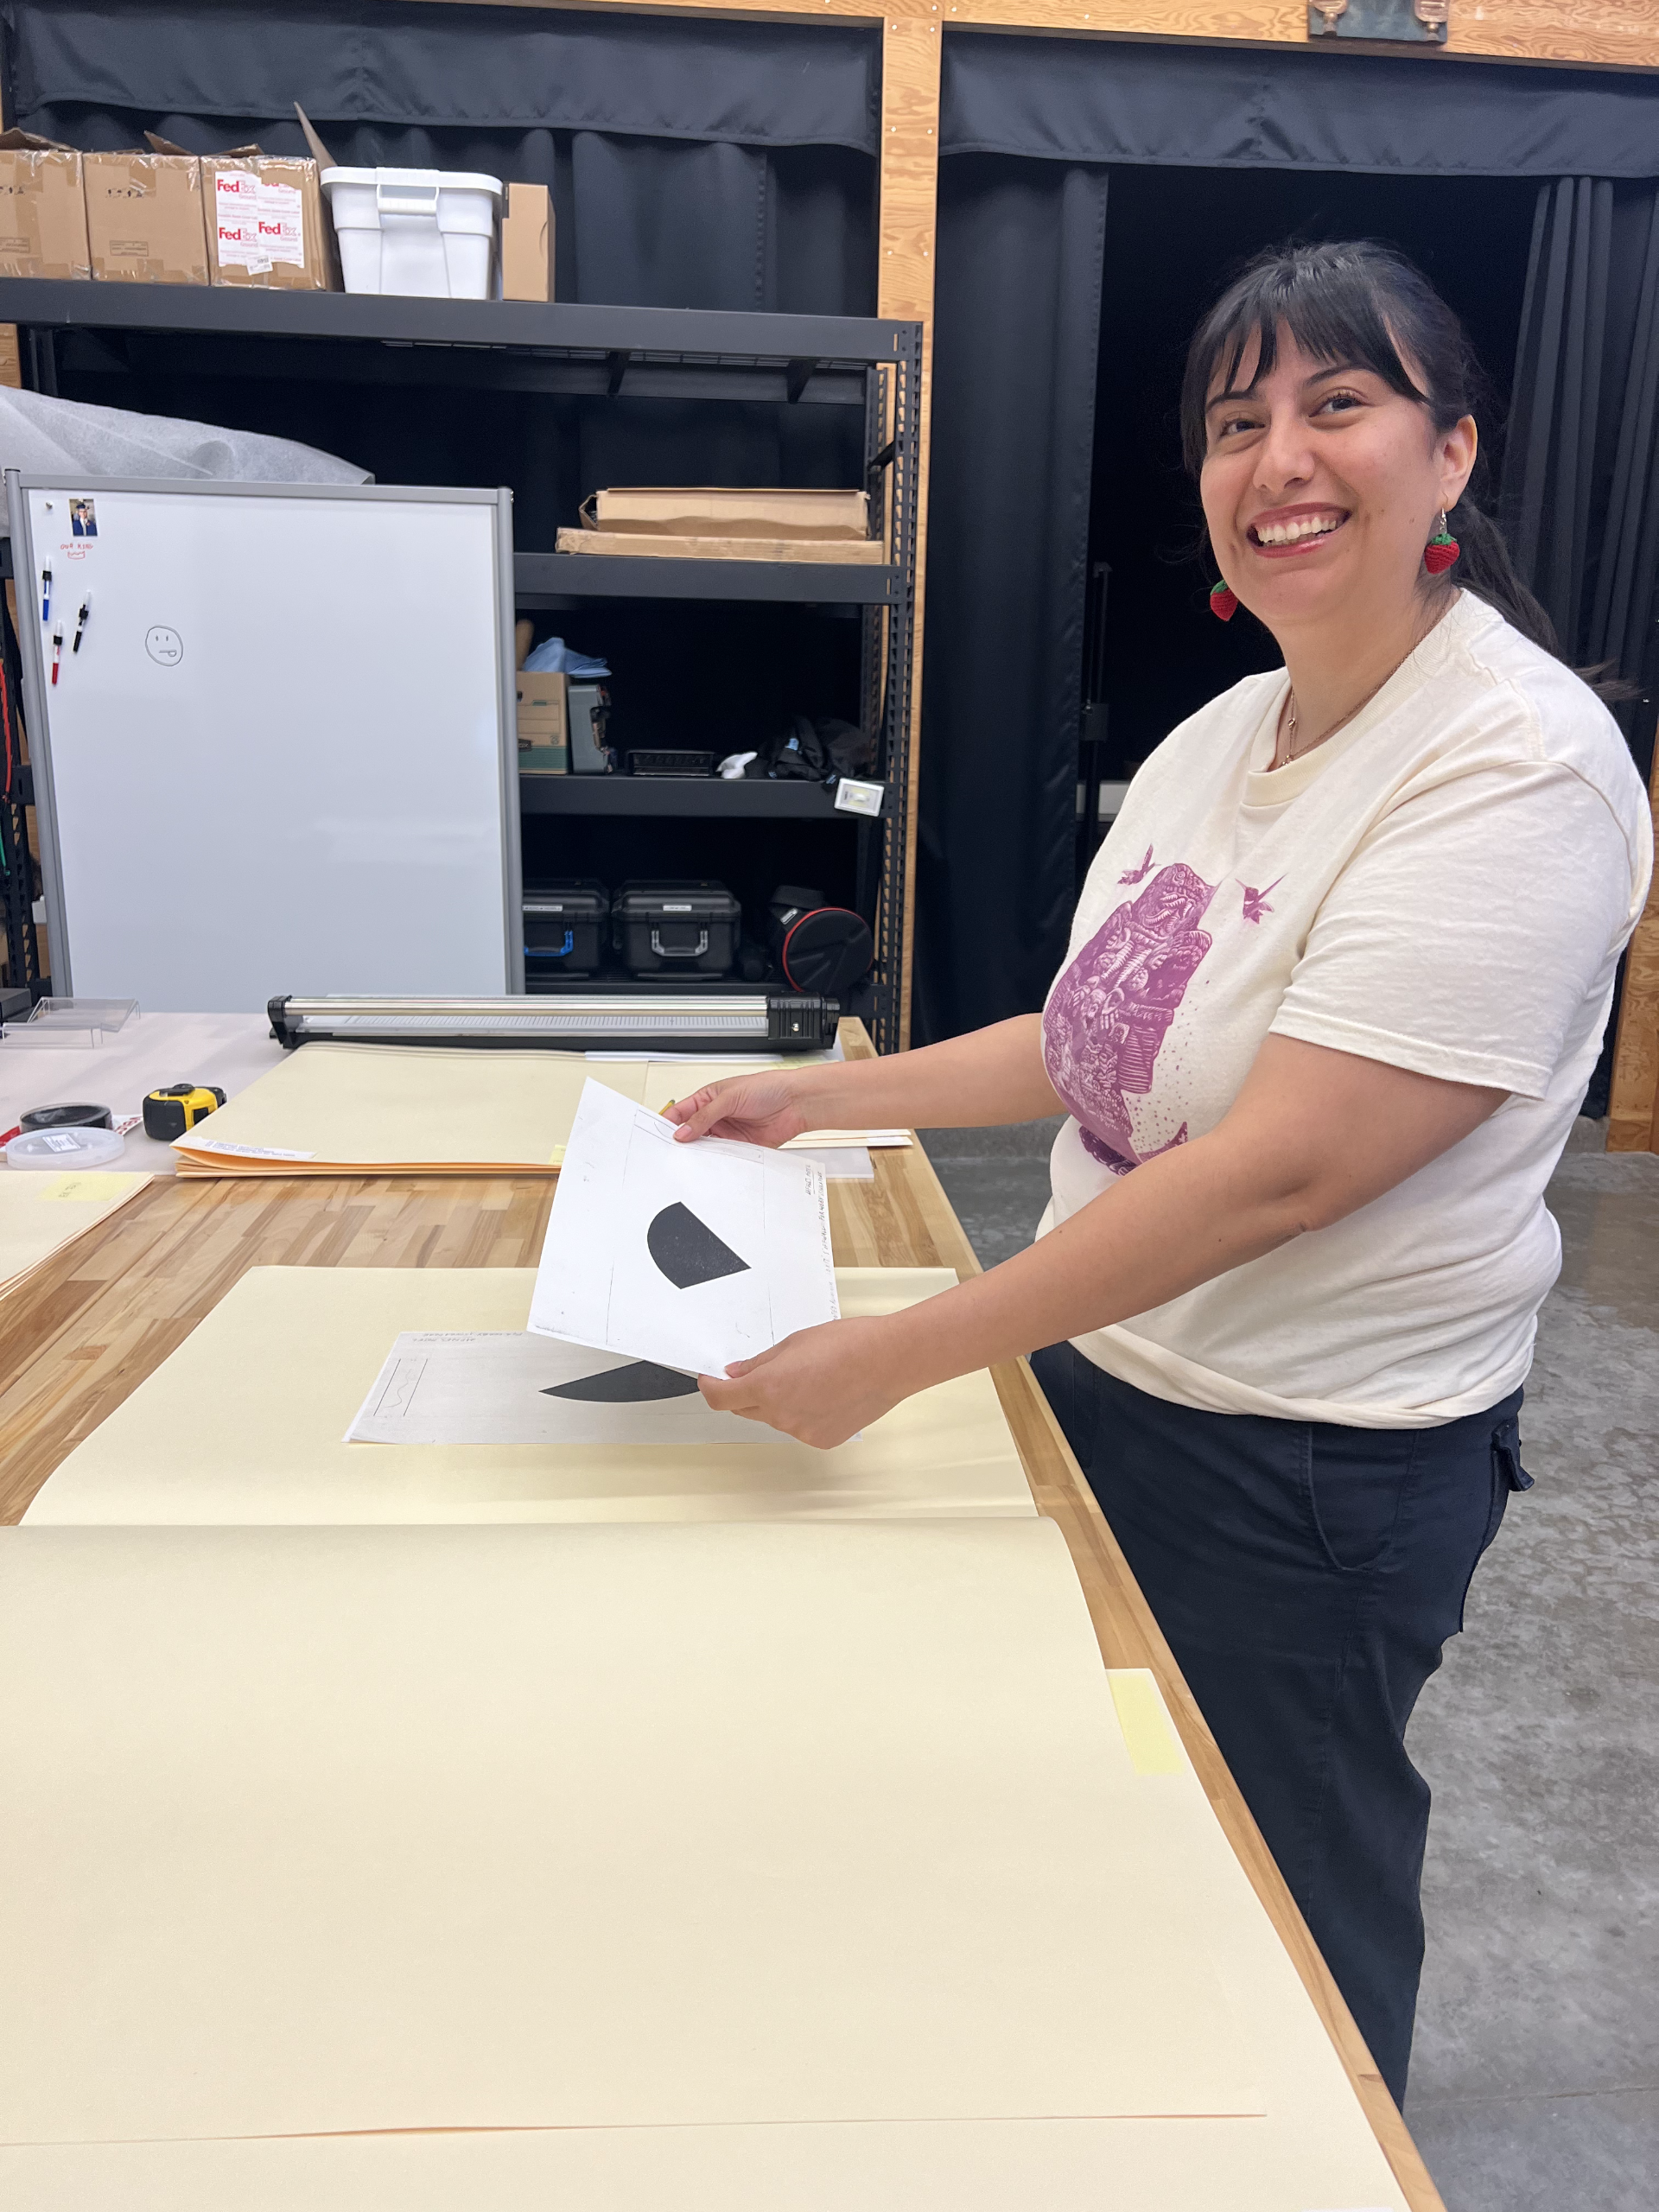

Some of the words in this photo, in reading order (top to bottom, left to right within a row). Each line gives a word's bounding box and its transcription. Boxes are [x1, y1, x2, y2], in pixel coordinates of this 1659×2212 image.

[217, 179, 256, 194] FedEx
[219, 227, 257, 242] FedEx
[258, 221, 297, 236] FedEx
